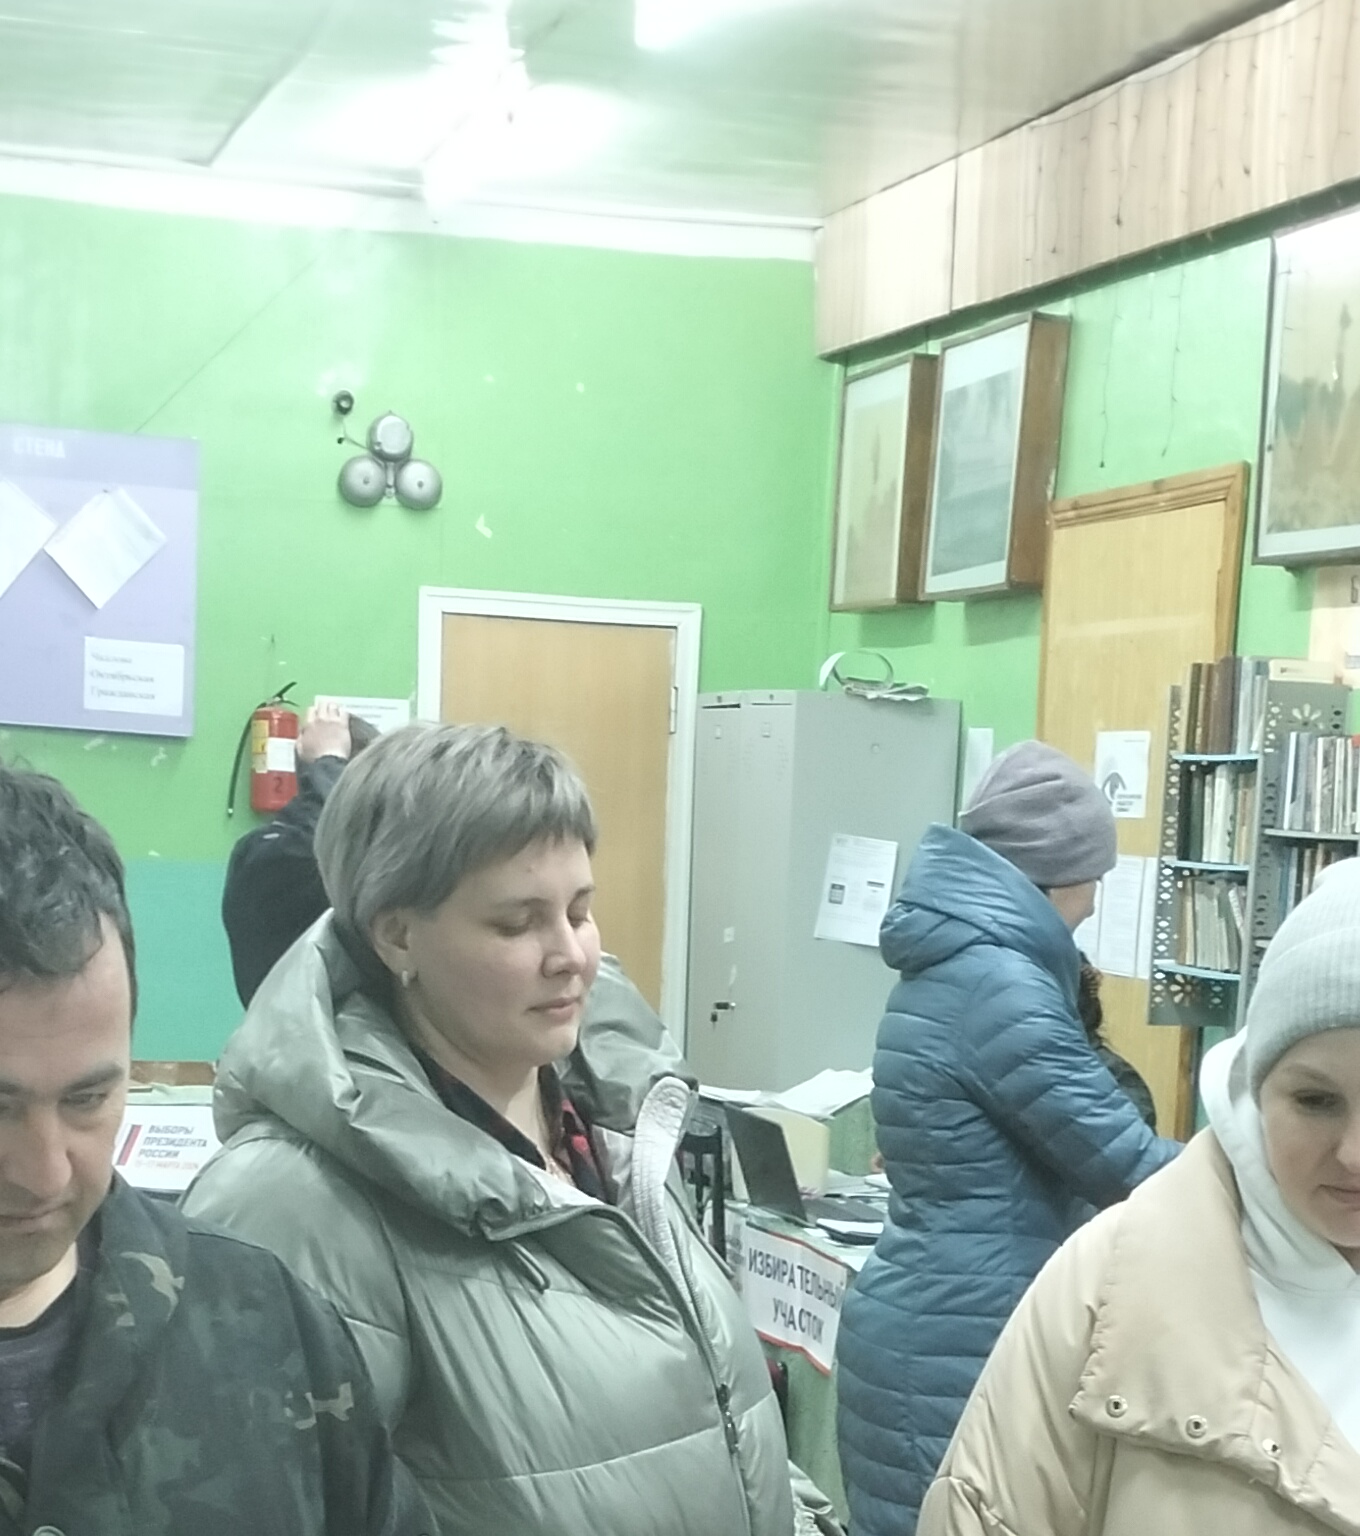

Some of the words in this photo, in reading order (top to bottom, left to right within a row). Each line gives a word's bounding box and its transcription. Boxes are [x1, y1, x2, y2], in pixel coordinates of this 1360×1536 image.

[273, 776, 284, 794] 2
[149, 1125, 194, 1134] ВЫБОРЫ
[143, 1137, 207, 1147] ПРЕЗИДЕНТА
[138, 1150, 180, 1158] РОССИИ
[773, 1298, 824, 1343] УЧАСТОК
